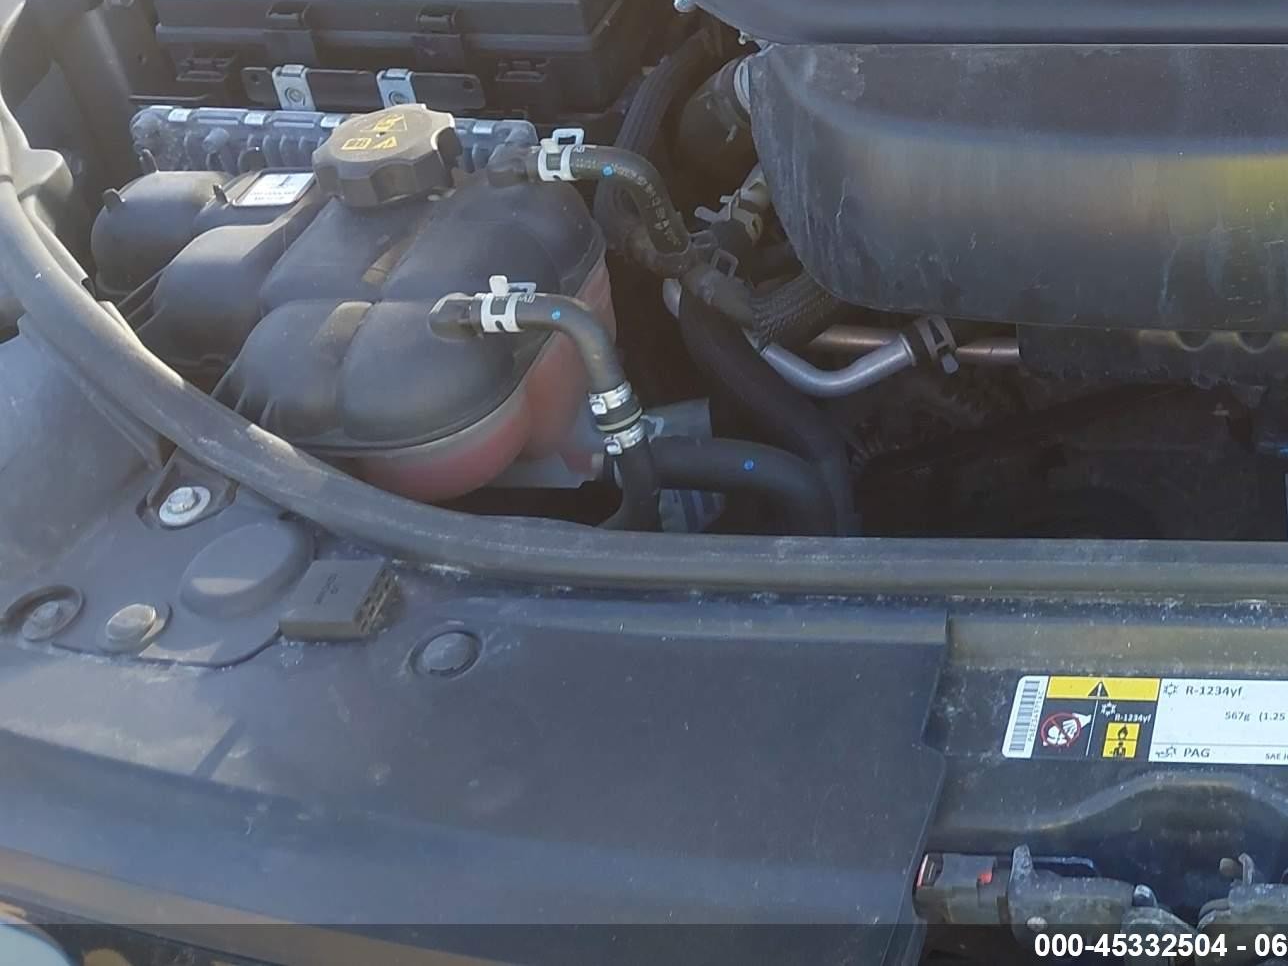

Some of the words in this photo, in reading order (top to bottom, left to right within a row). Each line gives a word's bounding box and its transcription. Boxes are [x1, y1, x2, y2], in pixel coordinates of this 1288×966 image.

[1185, 685, 1243, 698] R-1234yf
[1114, 713, 1151, 723] R-1234yf
[1225, 711, 1250, 722] 567g
[1258, 711, 1286, 722] (1.25
[1183, 748, 1210, 758] PAG
[1265, 752, 1281, 760] SAE
